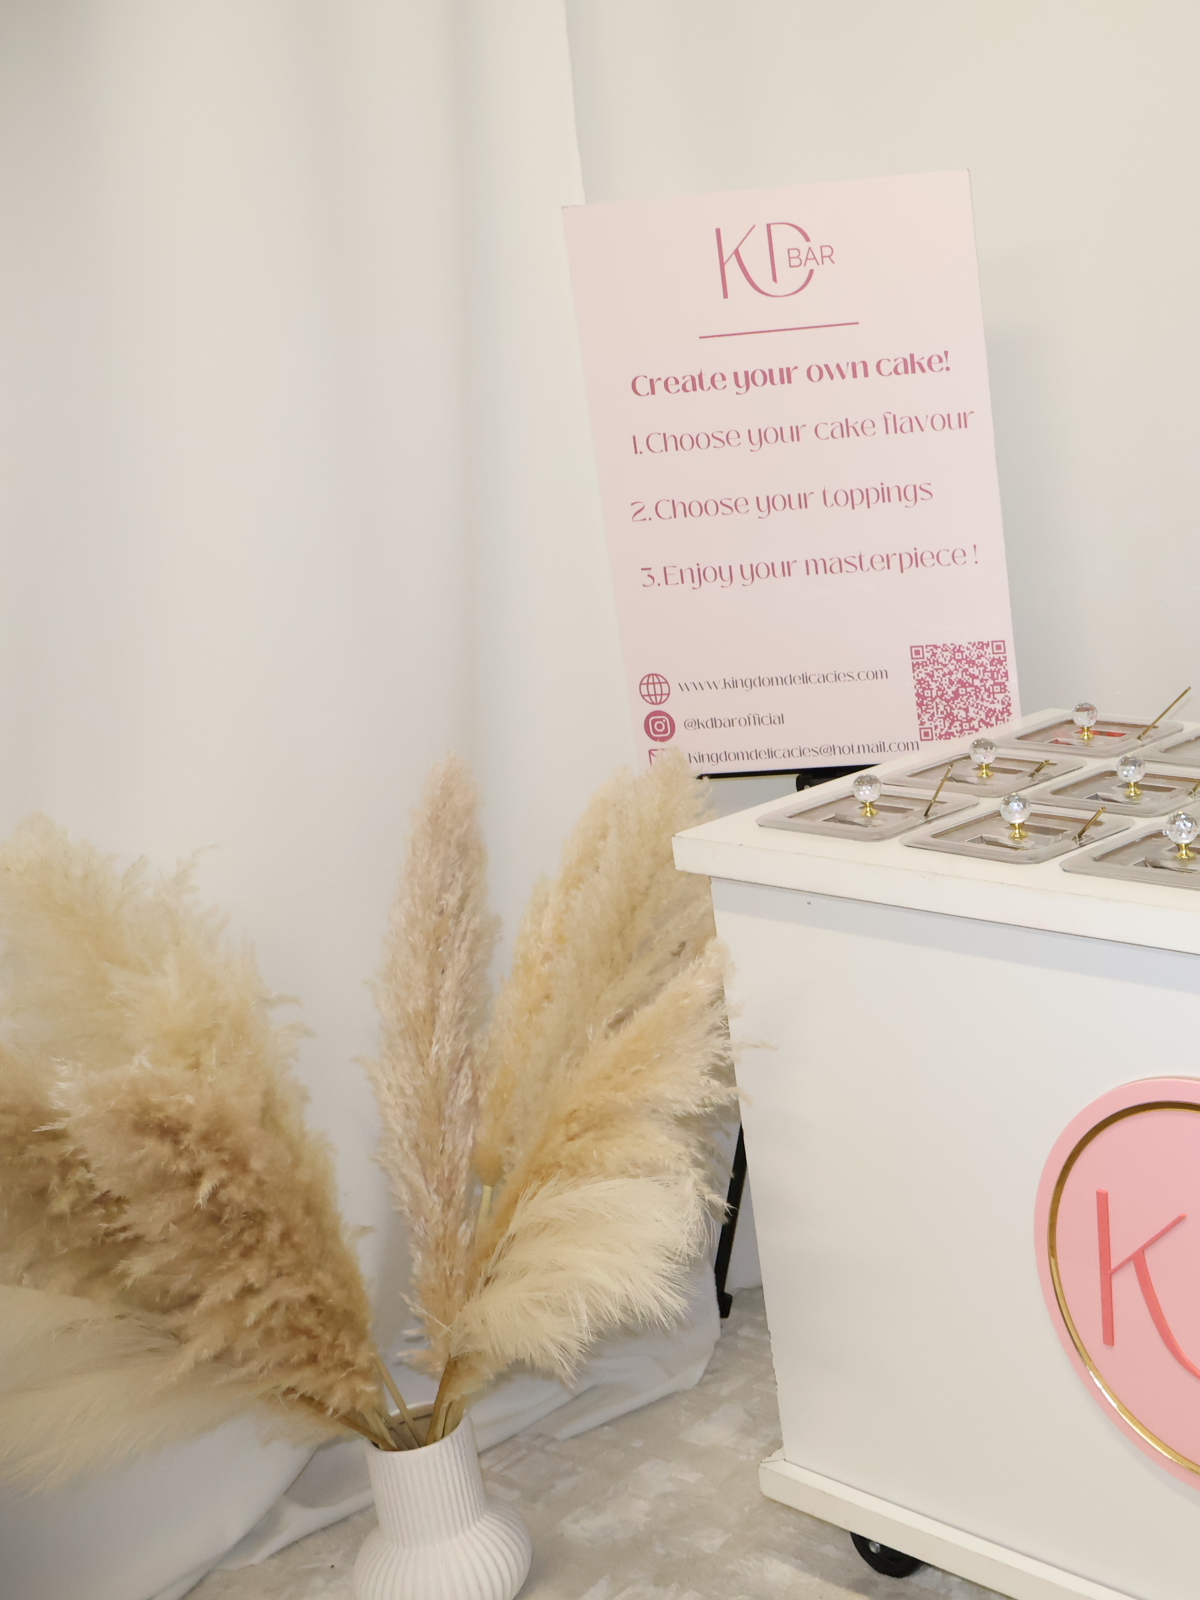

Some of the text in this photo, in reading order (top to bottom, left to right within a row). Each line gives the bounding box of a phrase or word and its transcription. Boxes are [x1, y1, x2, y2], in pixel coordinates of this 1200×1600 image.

[715, 222, 836, 299] KD BAR
[631, 350, 950, 396] Create your own cake!
[748, 425, 806, 452] your
[814, 418, 876, 440] cake
[882, 410, 975, 435] flavour
[631, 482, 933, 521] 2.Choose your toppings
[641, 563, 733, 590] 3.Enjoy
[740, 560, 797, 586] your
[678, 669, 889, 692] www.kingdomdelicacies.com
[683, 713, 785, 731] @kdbarofficial
